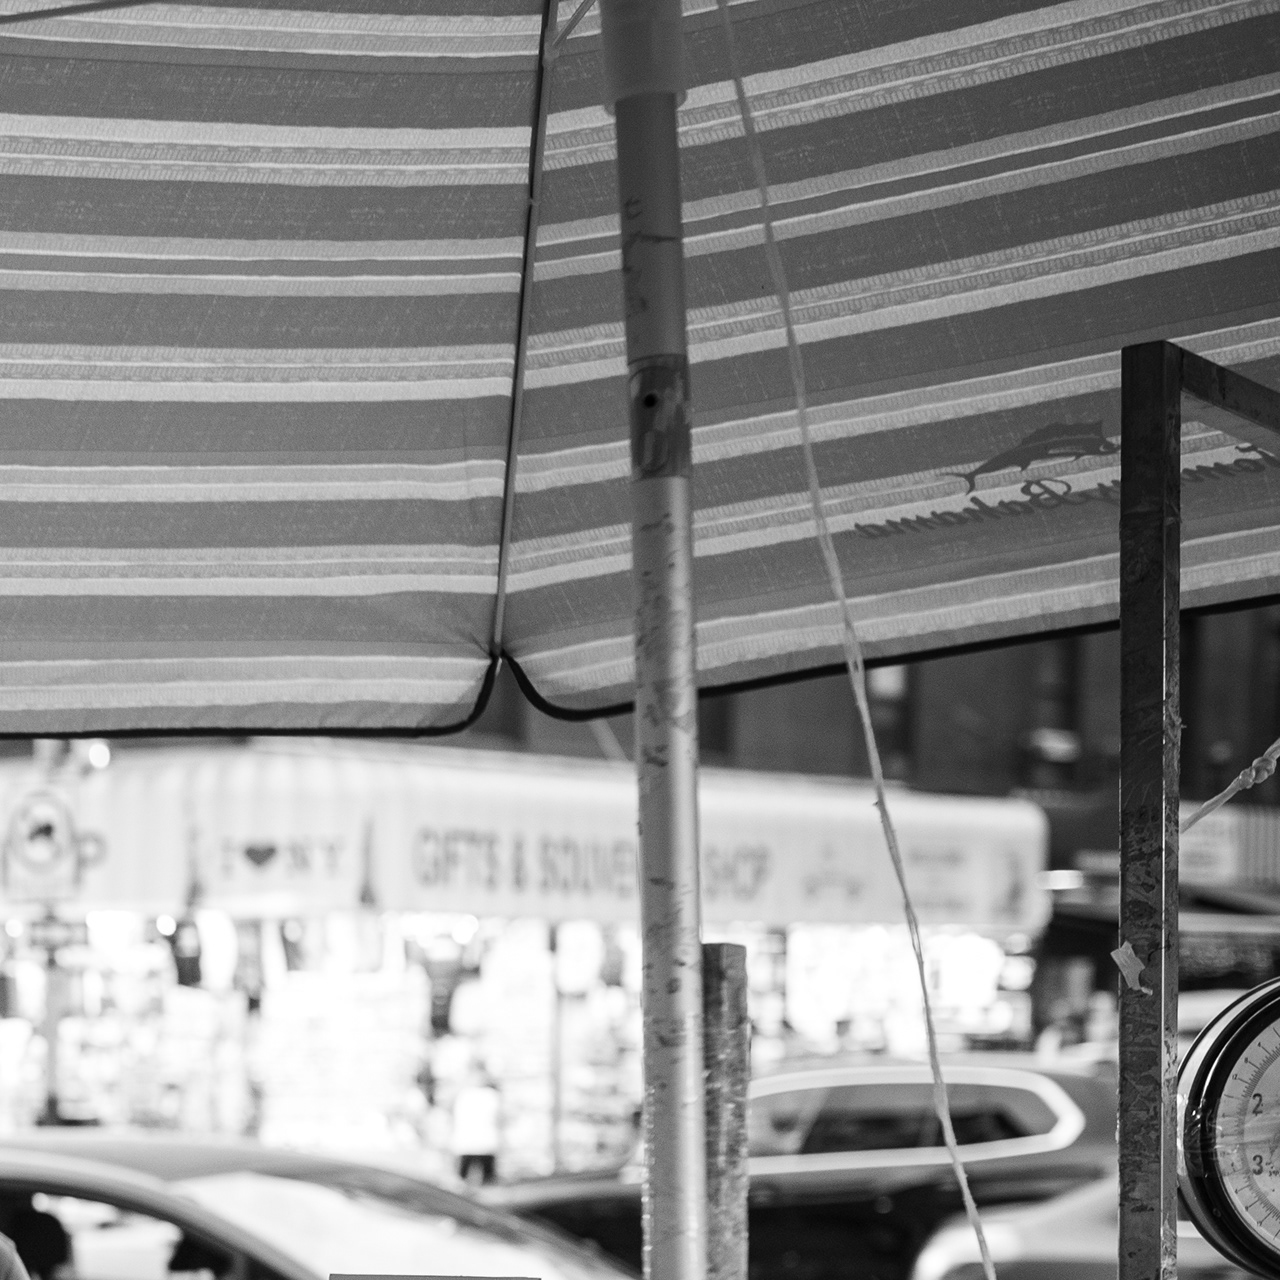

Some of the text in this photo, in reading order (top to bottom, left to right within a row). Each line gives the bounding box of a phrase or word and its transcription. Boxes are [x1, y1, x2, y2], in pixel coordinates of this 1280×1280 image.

[284, 834, 346, 879] NY
[412, 825, 504, 894] GIFTS
[1252, 1092, 1264, 1116] 2
[1252, 1154, 1264, 1176] 3
